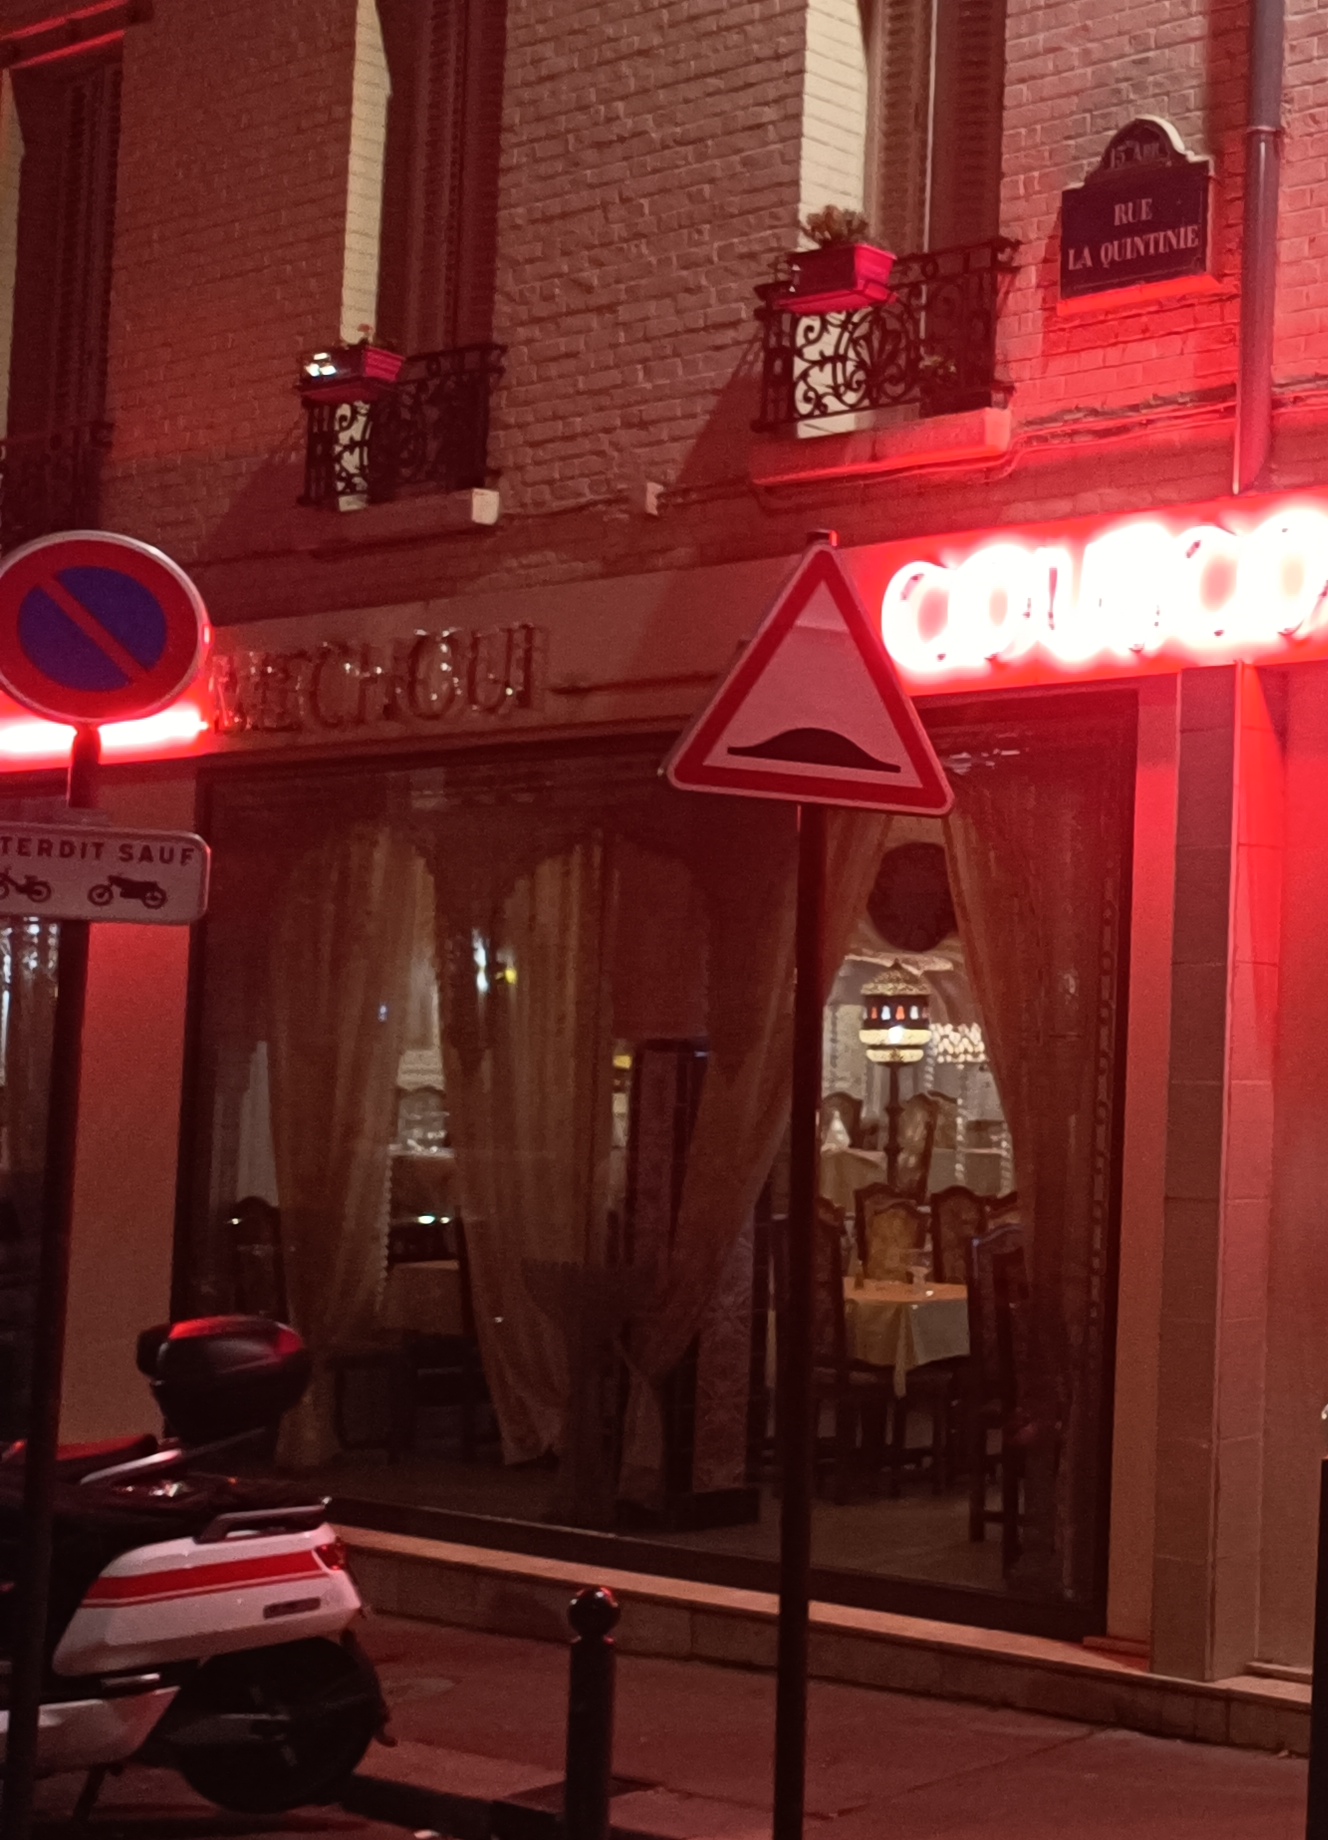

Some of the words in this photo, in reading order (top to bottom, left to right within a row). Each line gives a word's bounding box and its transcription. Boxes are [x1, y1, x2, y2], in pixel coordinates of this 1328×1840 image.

[1114, 199, 1153, 226] RUE
[1068, 246, 1093, 270] LA
[1101, 225, 1199, 268] QUINTINIE
[119, 843, 195, 866] SAUF
